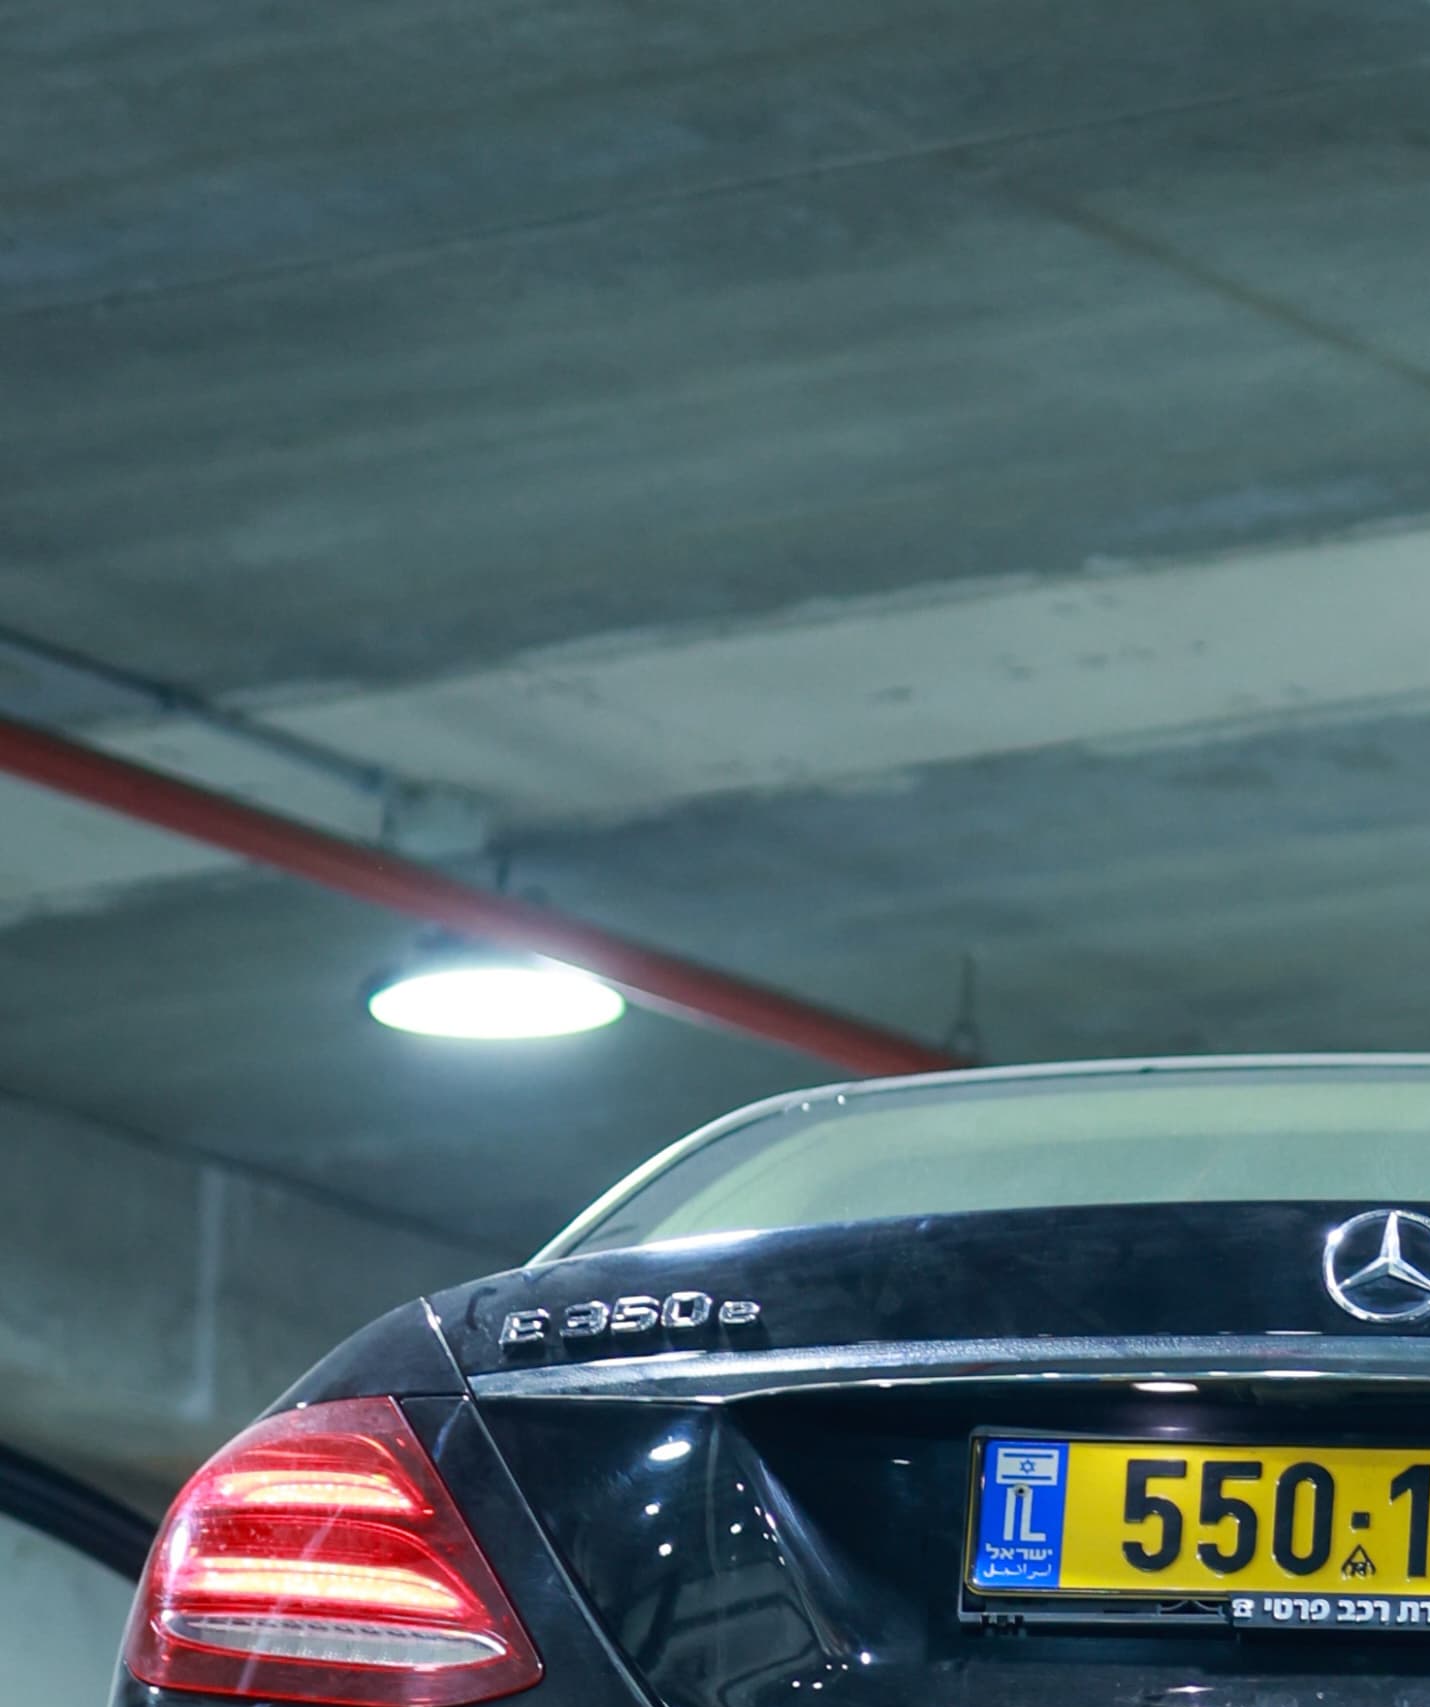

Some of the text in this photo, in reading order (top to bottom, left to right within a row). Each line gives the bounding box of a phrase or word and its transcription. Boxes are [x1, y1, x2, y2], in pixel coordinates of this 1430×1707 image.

[1003, 1486, 1046, 1542] IL
[985, 1543, 1053, 1560] ישראל
[1263, 1598, 1331, 1621] פרטי
[1337, 1599, 1390, 1622] רכב
